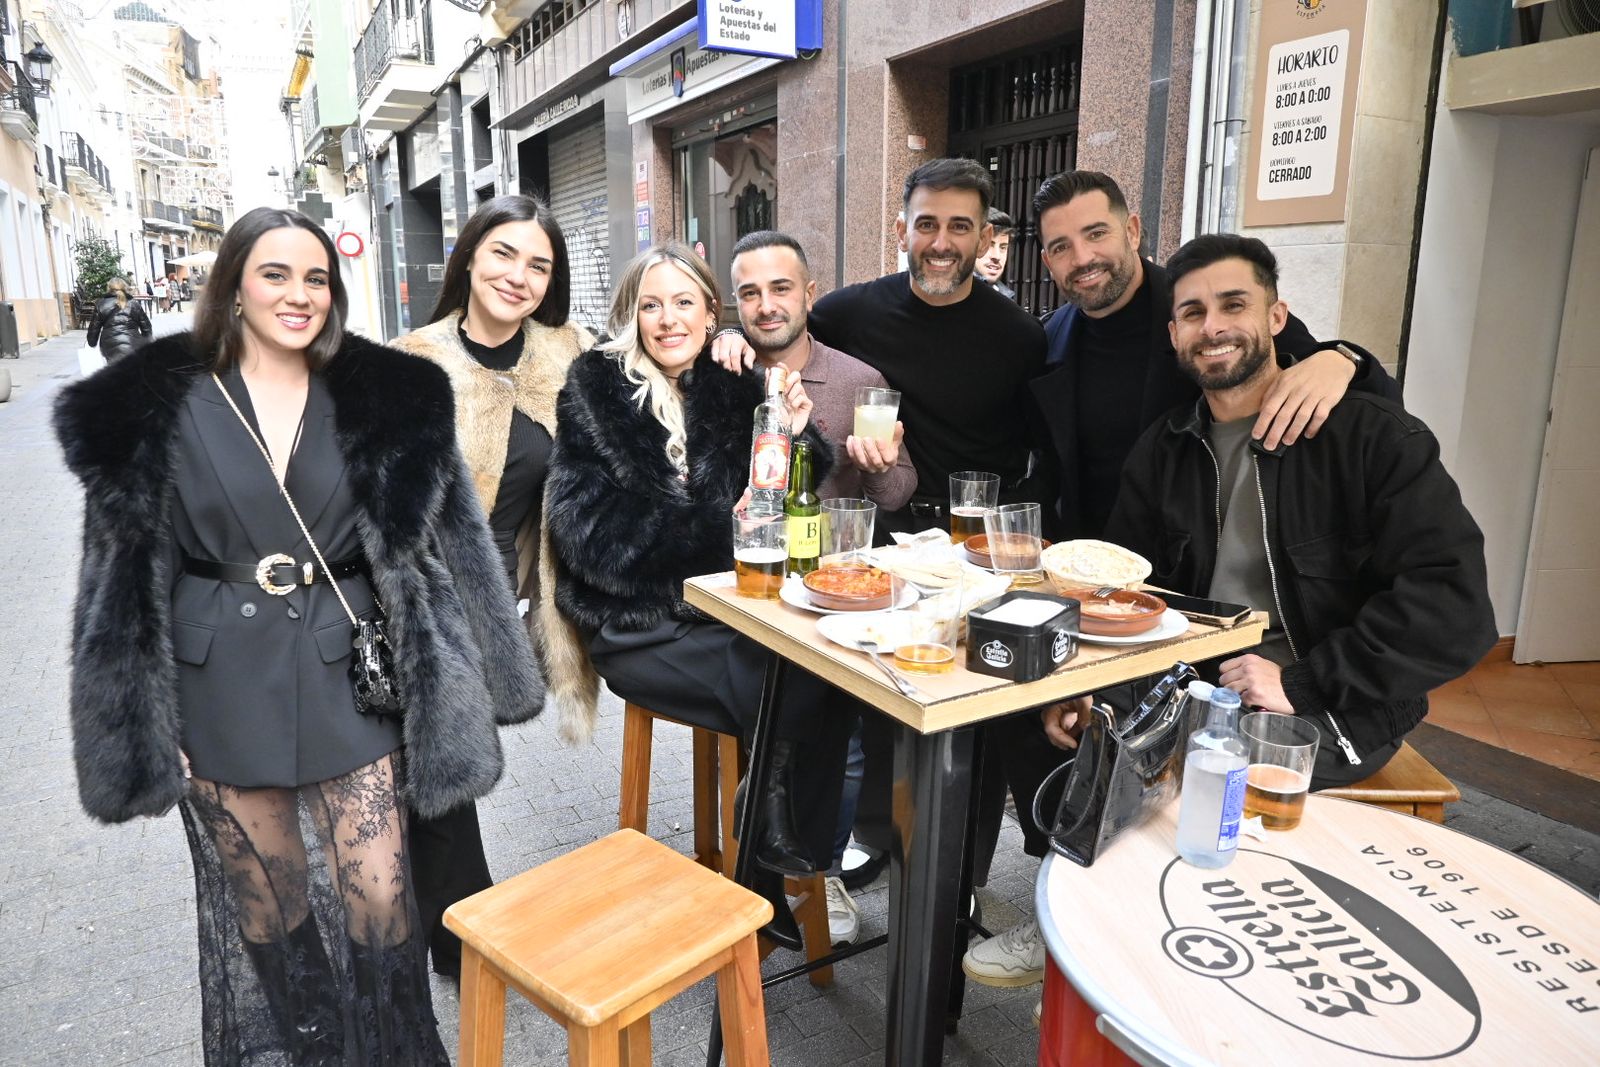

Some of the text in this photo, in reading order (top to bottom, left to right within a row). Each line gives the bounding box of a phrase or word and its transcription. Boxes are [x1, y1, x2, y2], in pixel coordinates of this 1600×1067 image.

[720, 16, 777, 33] Apuestas del
[758, 11, 763, 20] y
[719, 29, 751, 42] Estado
[1277, 44, 1339, 76] HORARIO
[1275, 85, 1331, 110] 8:00 A 0:00
[1272, 125, 1327, 147] 8:00 A 2:00
[1268, 165, 1312, 184] CERRADO
[806, 522, 818, 539] B
[1406, 846, 1600, 988] ESDE 1906
[1361, 844, 1600, 1014] RESISTENCIA
[1202, 878, 1378, 1018] Estrella
[1261, 878, 1421, 1006] Galicia
